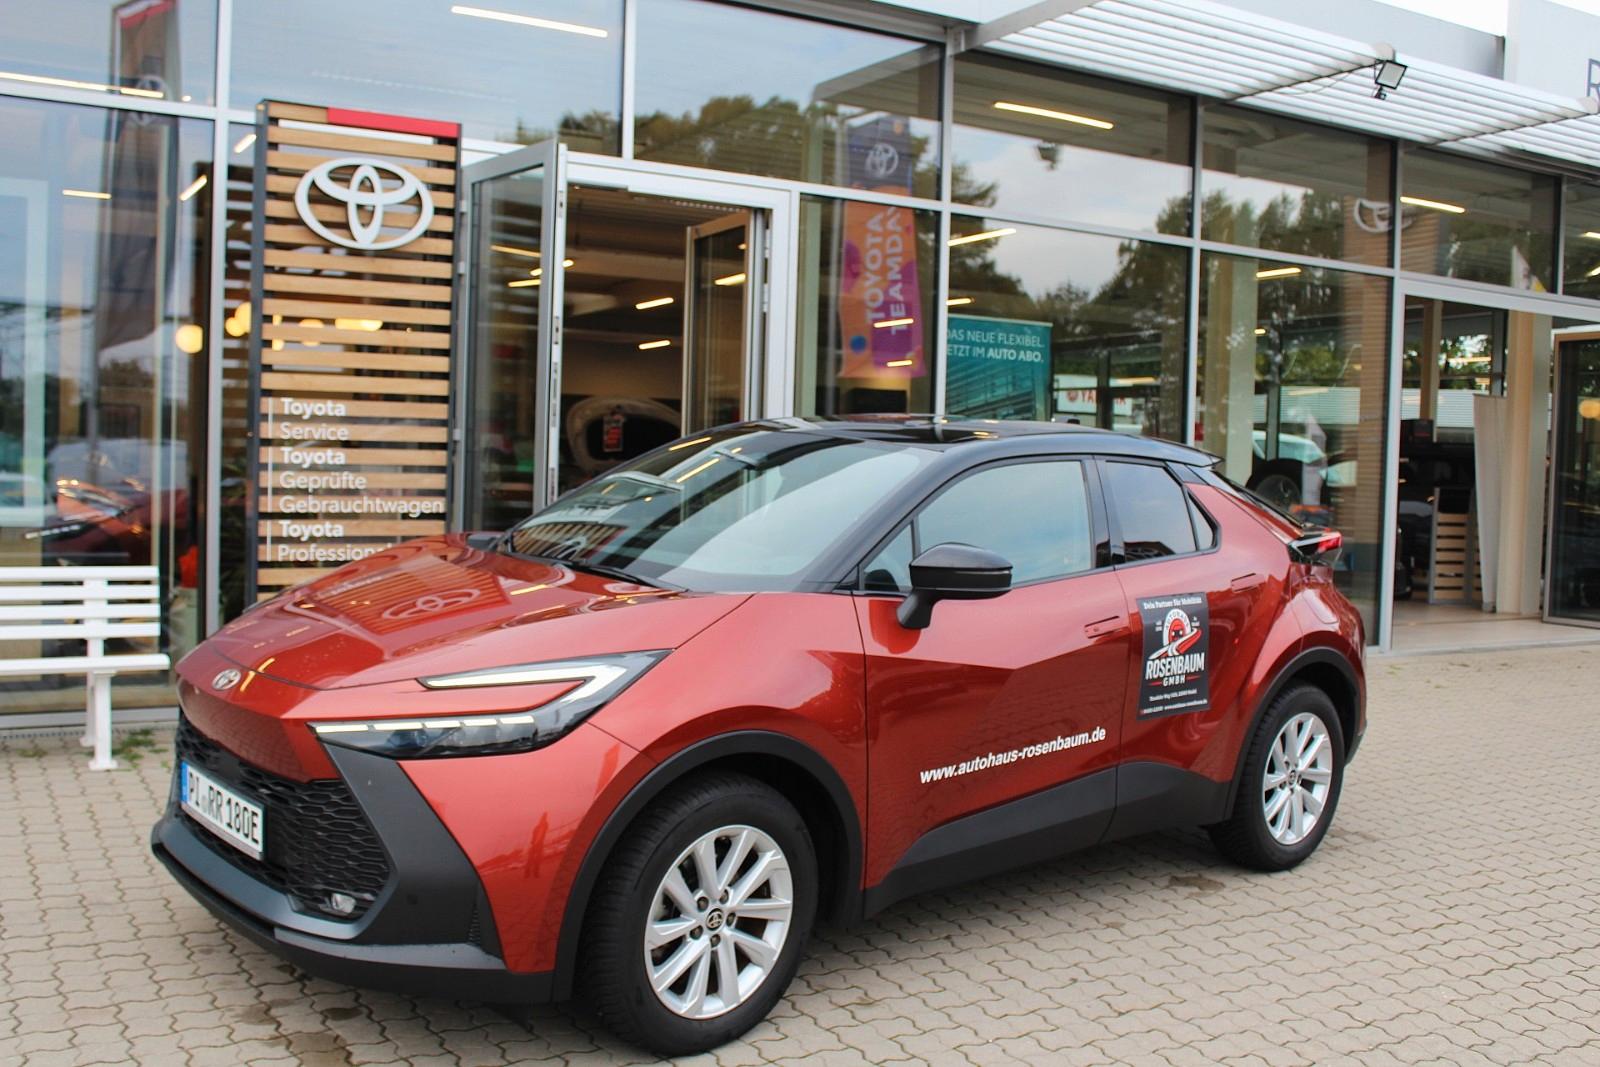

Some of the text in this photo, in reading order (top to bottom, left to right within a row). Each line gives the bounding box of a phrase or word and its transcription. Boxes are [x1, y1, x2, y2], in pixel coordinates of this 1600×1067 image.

[863, 210, 886, 324] TOYOTA
[966, 329, 996, 344] NEUE
[997, 331, 1045, 348] FLEXIBEL.
[947, 343, 1044, 364] ETZT IM AUTO ABO.
[280, 397, 347, 420] Toyota
[280, 421, 349, 441] Service
[280, 446, 346, 469] Toyota
[279, 471, 367, 493] Geprüfte
[278, 494, 446, 518] Gebrauchtwagen
[278, 519, 345, 541] Toyota
[277, 543, 394, 562] Profession
[1145, 652, 1205, 681] ROSENBAUM
[1162, 674, 1186, 687] GMBH
[919, 725, 1107, 785] www.autohaus-rosenbaum.de
[207, 784, 224, 825] RR
[225, 797, 260, 845] 180E
